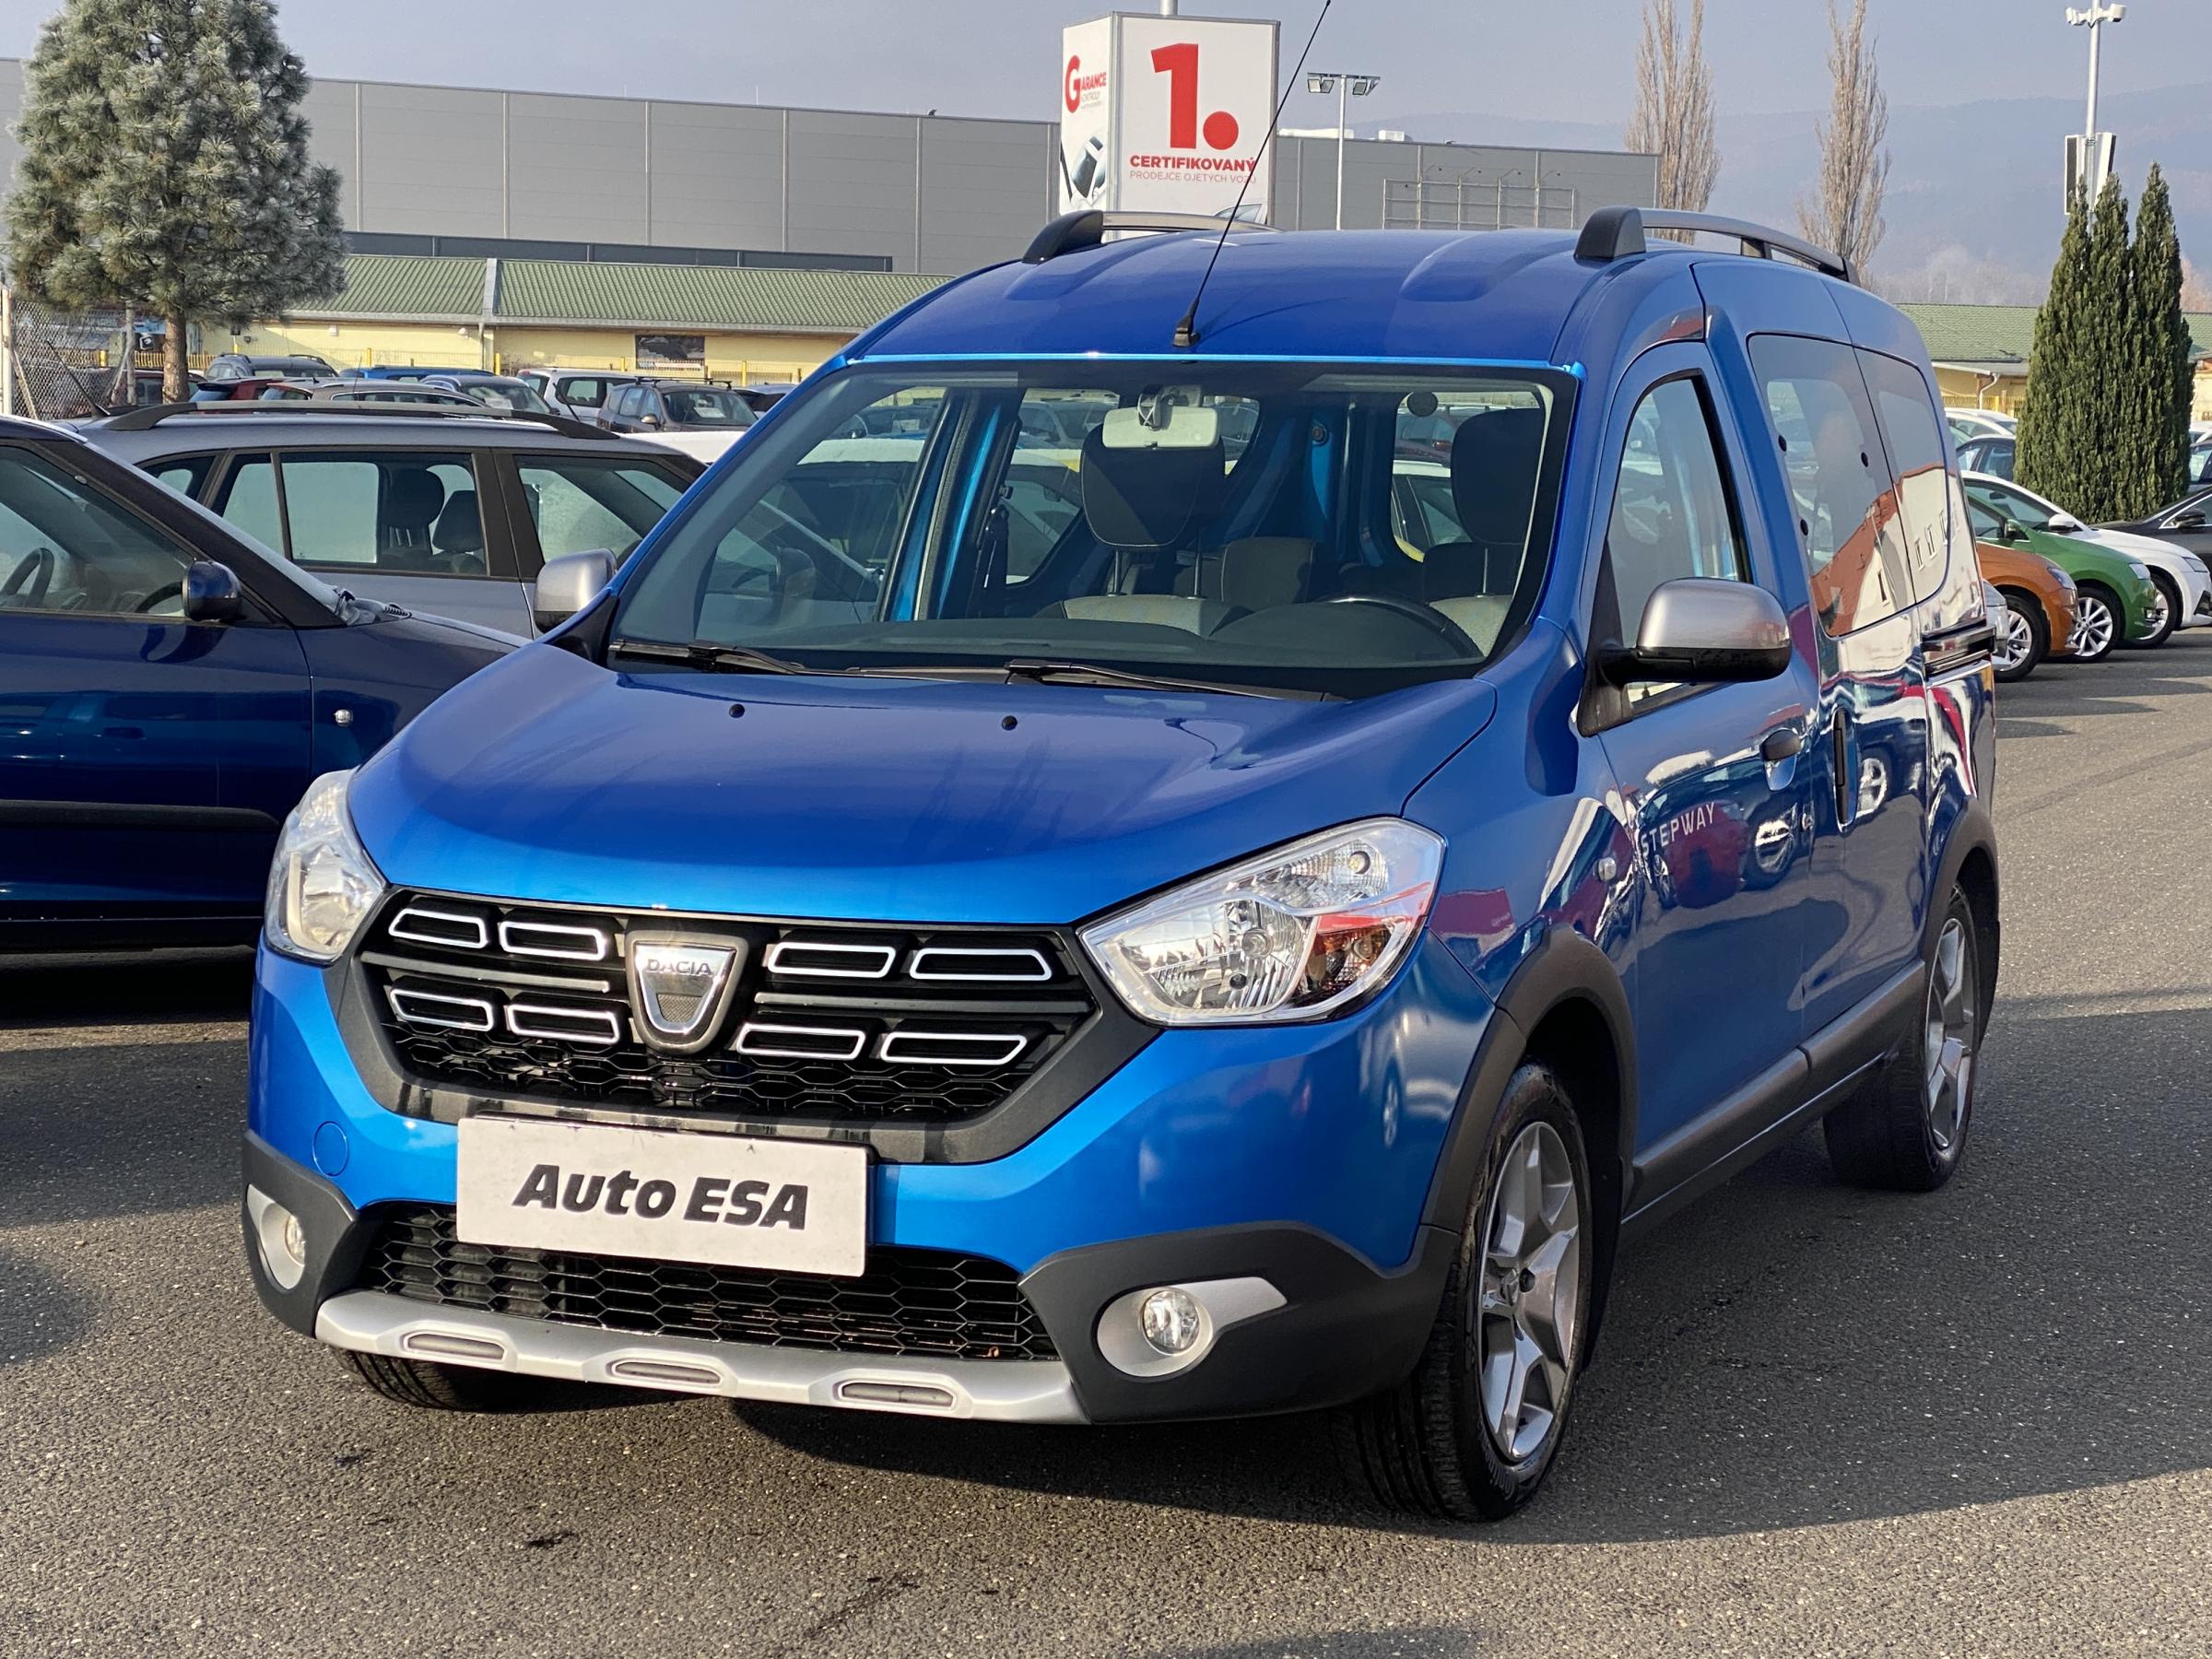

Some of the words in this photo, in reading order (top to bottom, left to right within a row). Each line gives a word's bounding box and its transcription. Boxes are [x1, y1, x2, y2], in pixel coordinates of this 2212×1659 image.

[1065, 55, 1107, 113] GARANCE
[1150, 42, 1240, 150] 1.
[1129, 155, 1256, 171] CERTIFIKOVANÝ
[1129, 171, 1182, 182] PRODEJCE
[1641, 801, 1716, 858] STEPWAY
[646, 959, 714, 977] DACIA
[512, 1164, 676, 1219] Auto
[683, 1176, 809, 1231] ESA
